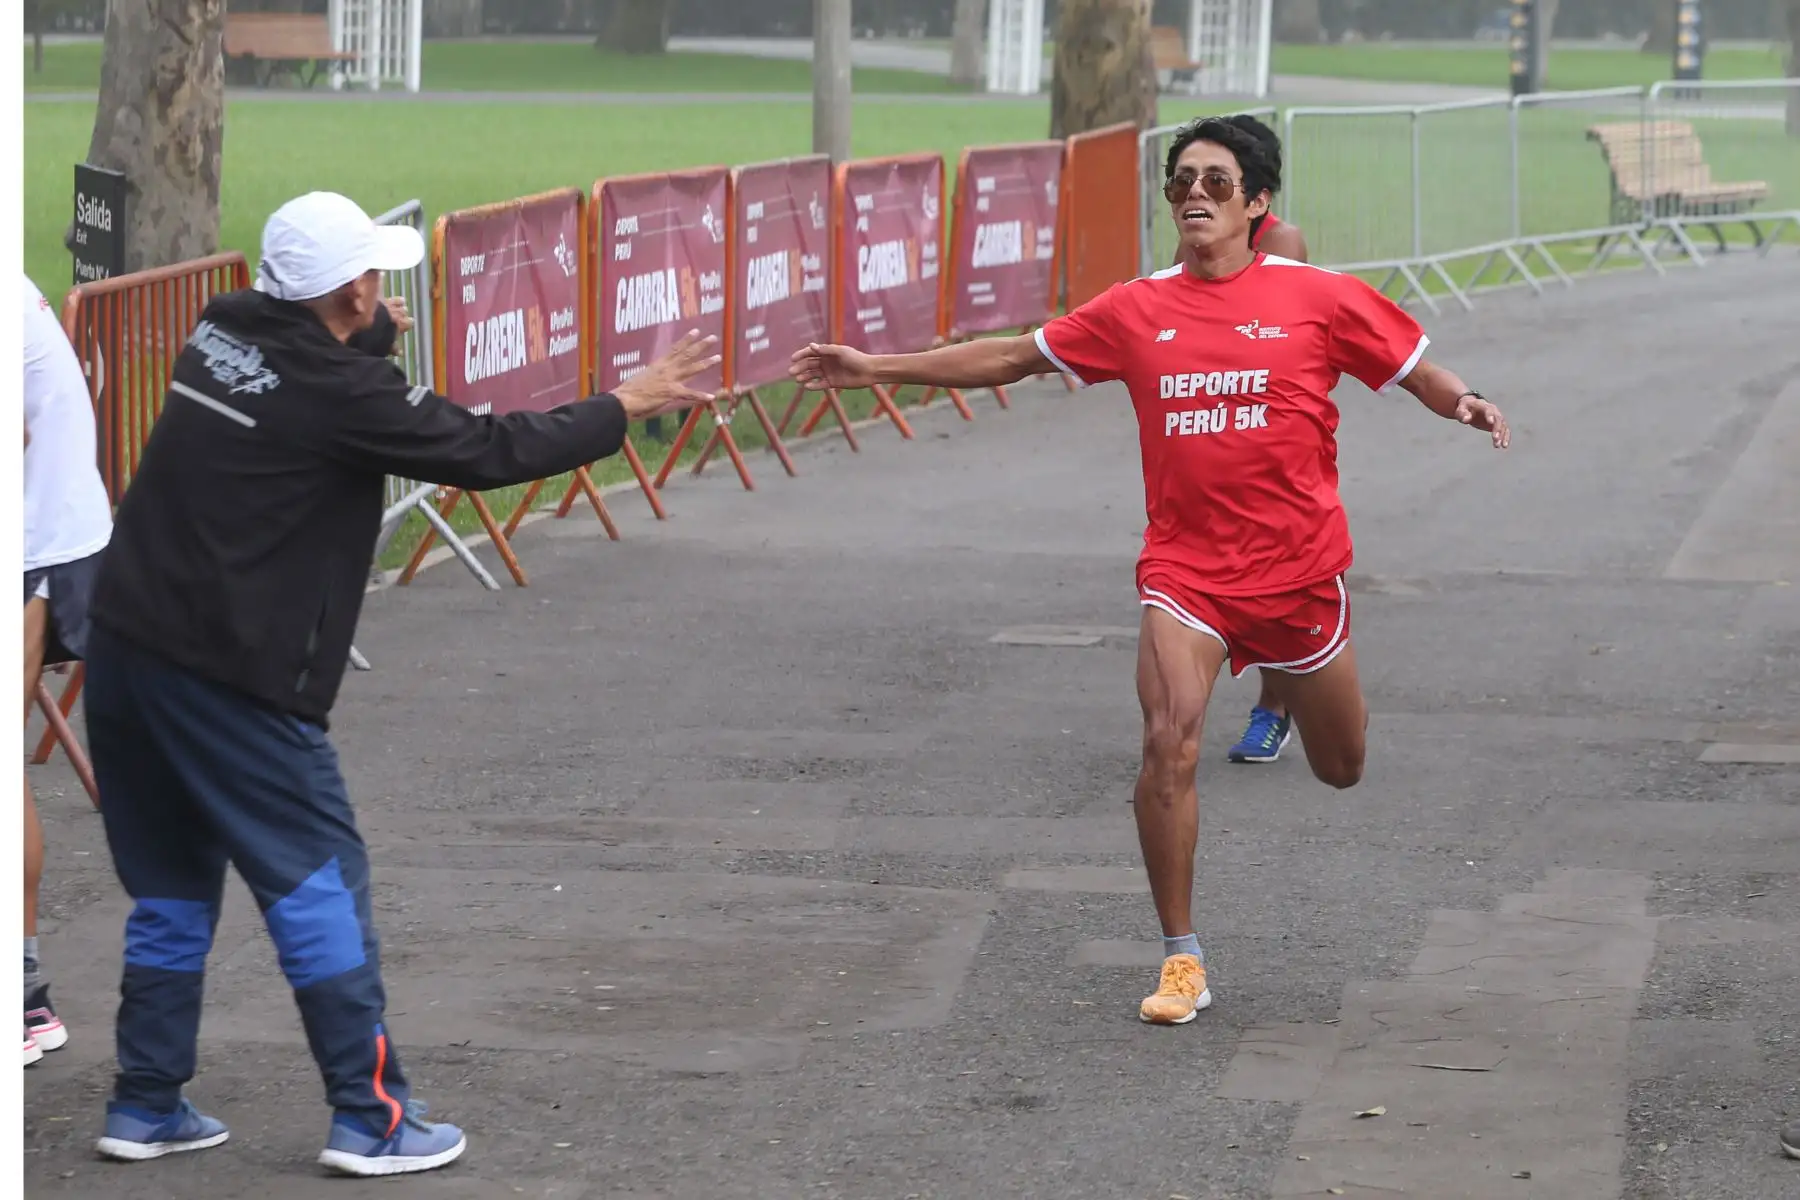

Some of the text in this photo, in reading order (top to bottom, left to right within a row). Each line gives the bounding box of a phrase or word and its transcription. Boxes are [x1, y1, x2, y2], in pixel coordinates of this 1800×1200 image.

[77, 192, 112, 232] Salida
[76, 228, 87, 245] Exit
[460, 254, 486, 277] DEPORTE
[462, 279, 477, 305] PERÚ
[615, 267, 681, 334] CARRERA
[464, 308, 527, 385] CARRERA
[1160, 369, 1269, 399] DEPORTE
[1165, 402, 1269, 436] PERÚ 5K
